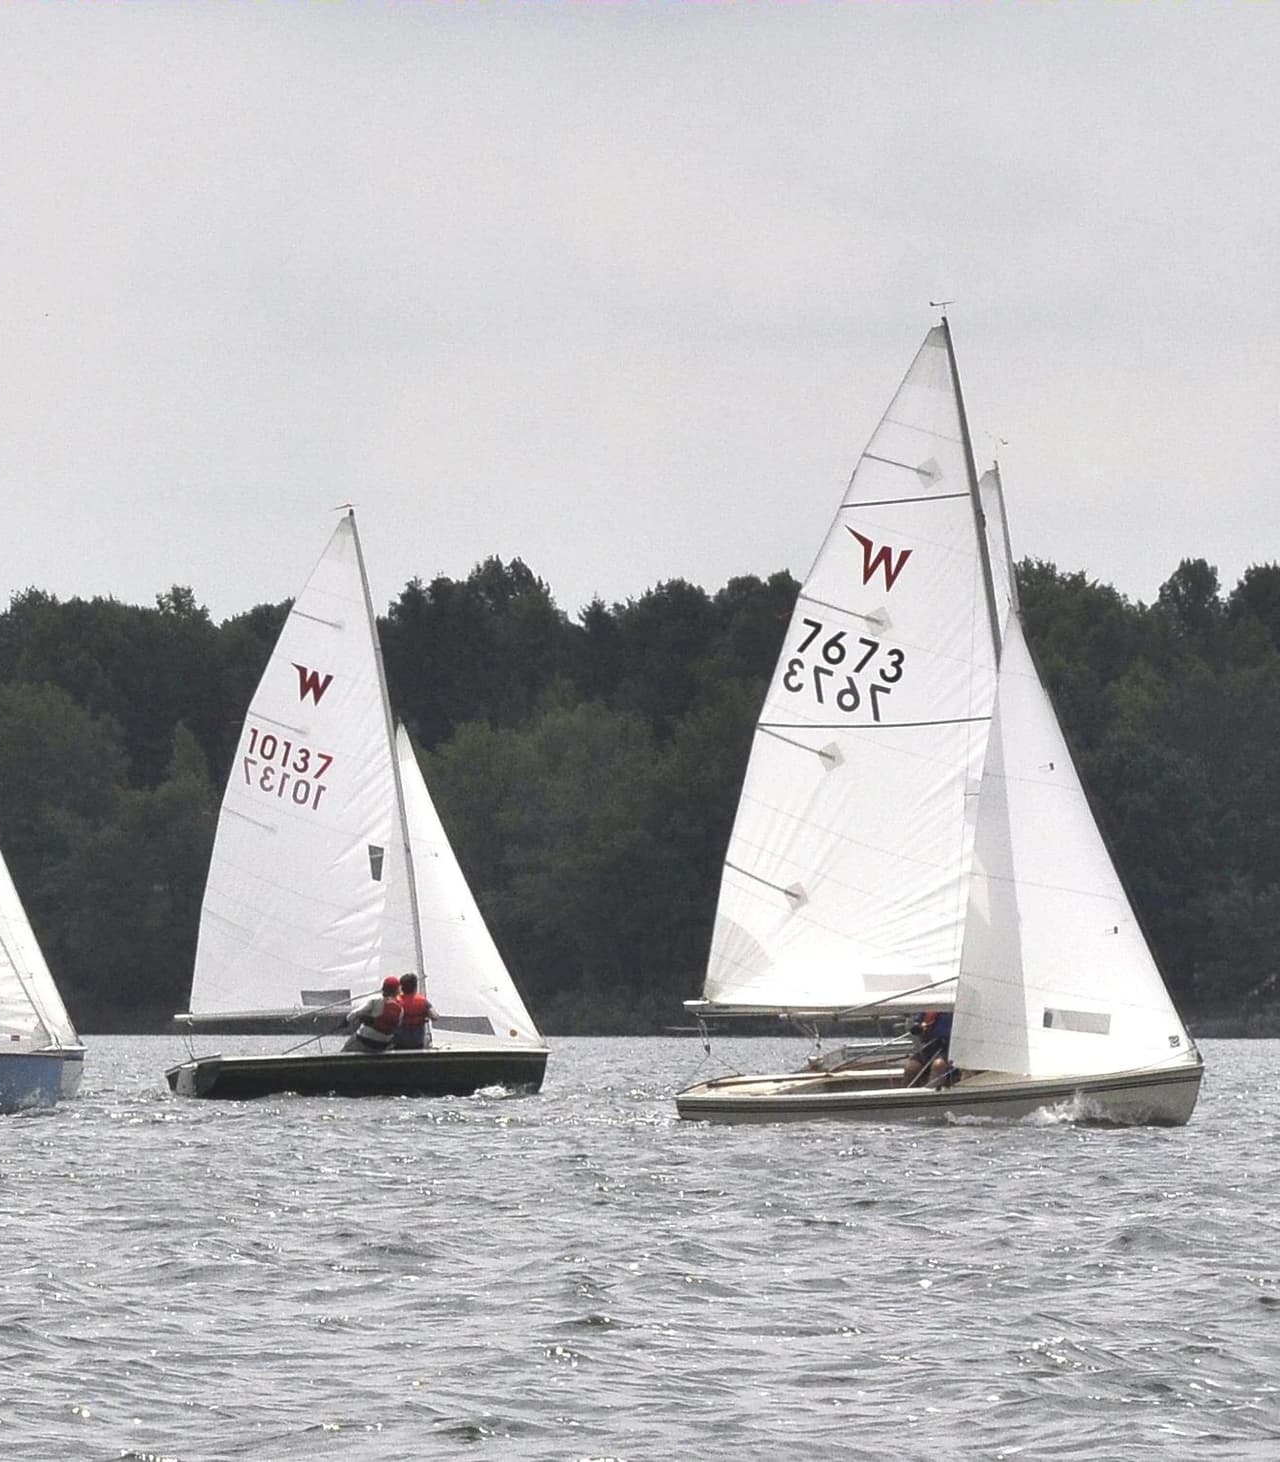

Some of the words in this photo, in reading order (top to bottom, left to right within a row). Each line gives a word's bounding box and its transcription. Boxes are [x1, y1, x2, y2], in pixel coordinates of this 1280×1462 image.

[845, 526, 913, 592] W
[797, 618, 905, 683] 7673
[291, 662, 334, 706] W
[249, 728, 334, 779] 10137
